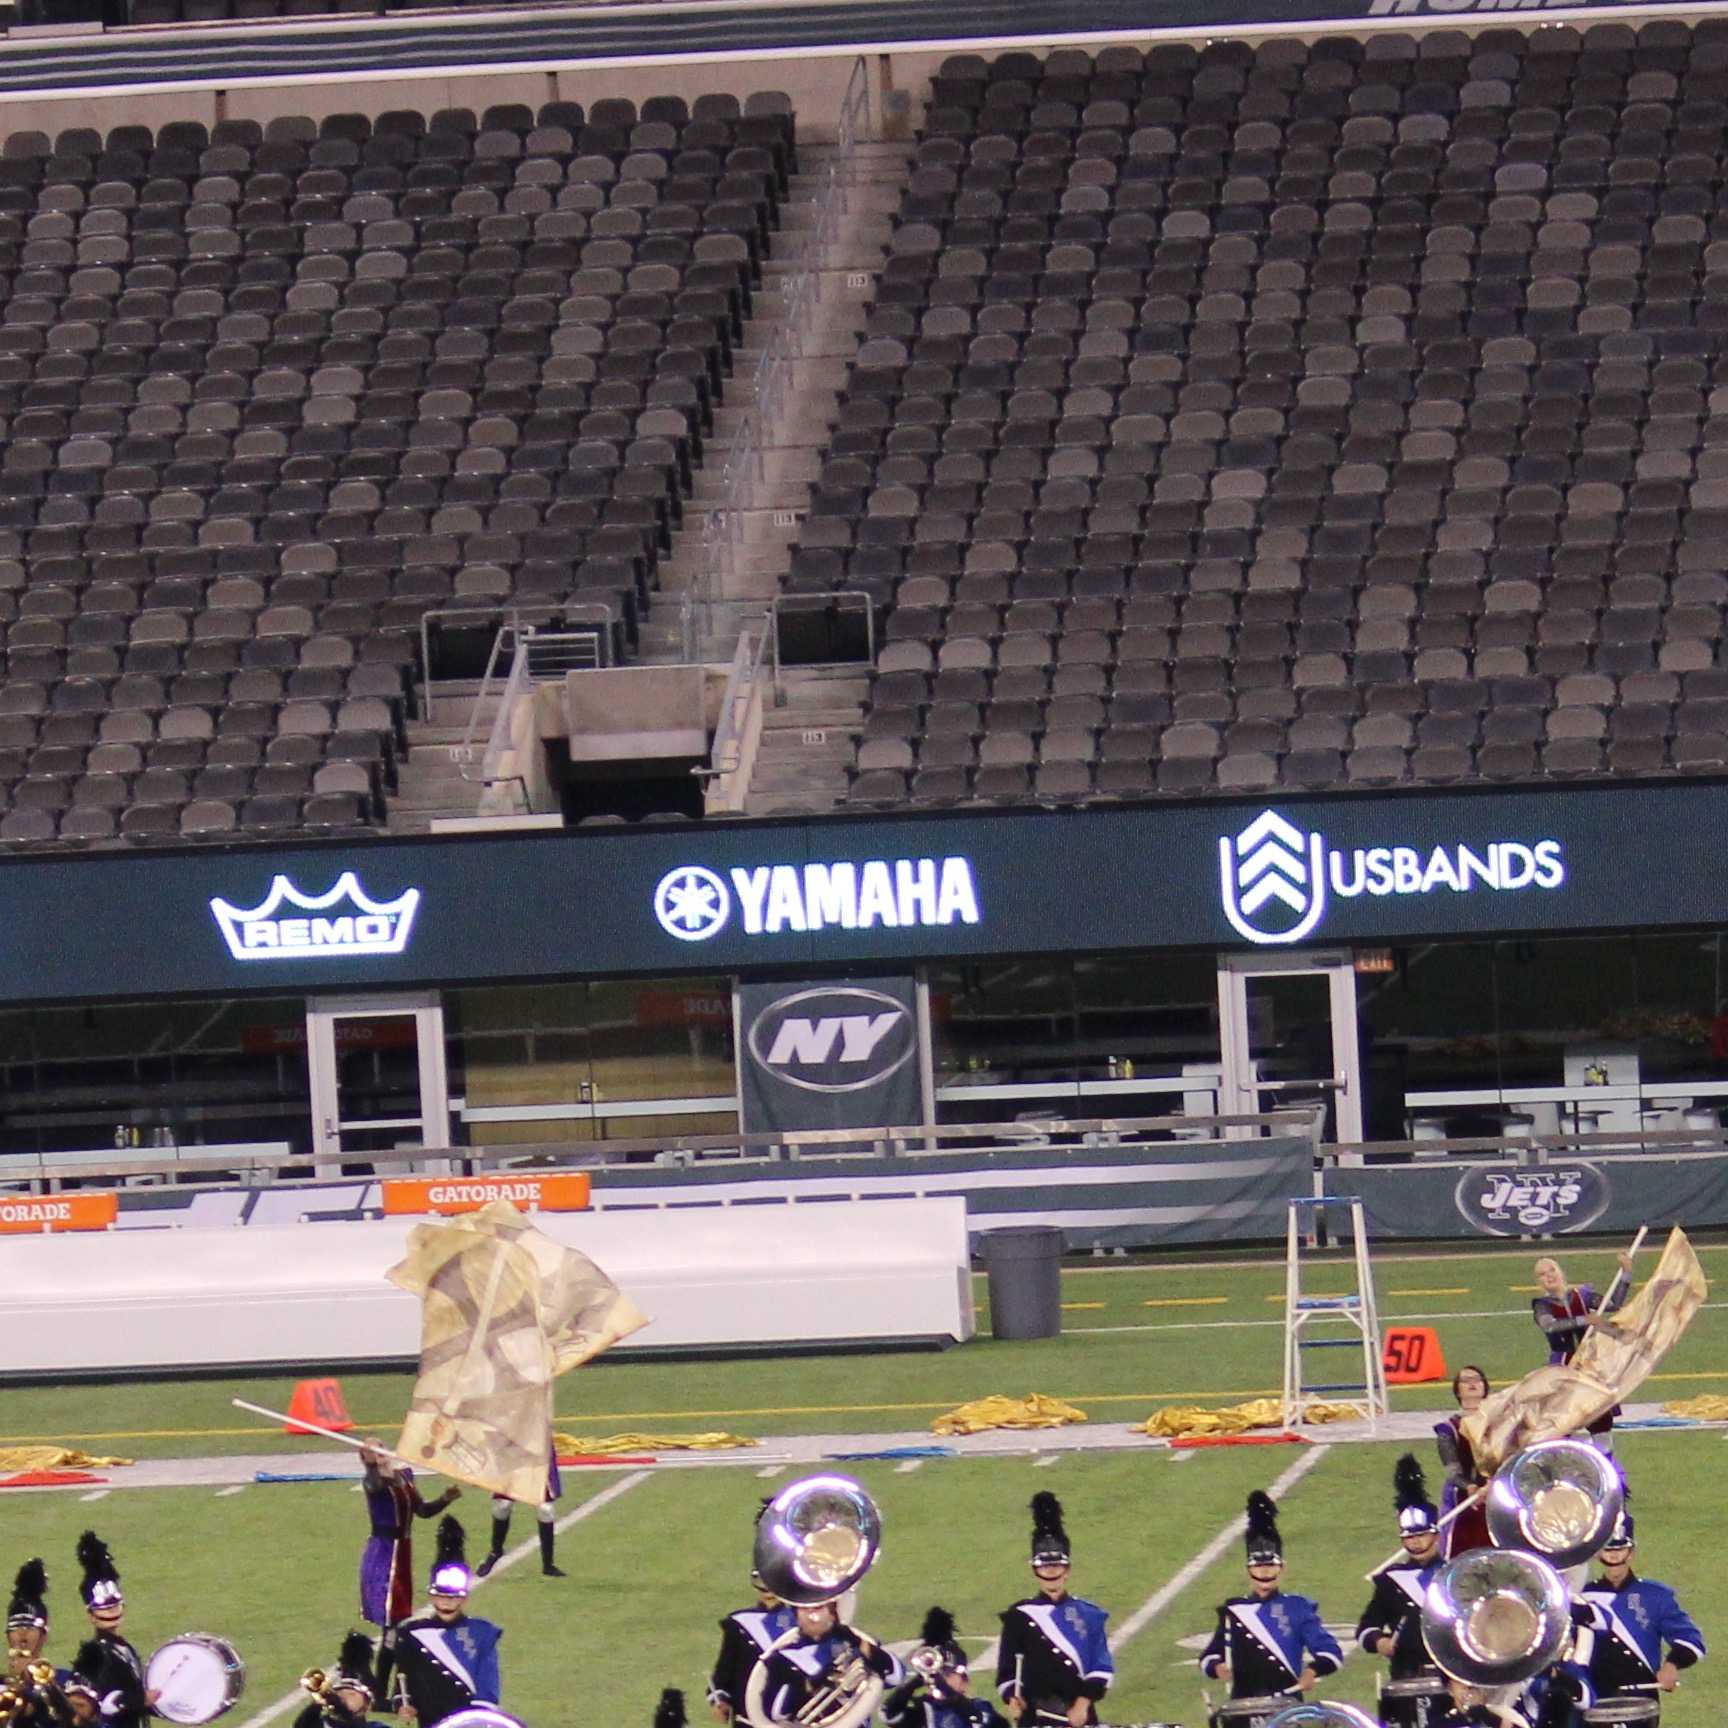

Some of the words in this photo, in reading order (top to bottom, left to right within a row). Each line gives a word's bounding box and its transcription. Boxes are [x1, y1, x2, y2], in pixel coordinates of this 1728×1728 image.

[1329, 840, 1565, 897] USBANDS
[730, 856, 979, 934] YAMAHA
[243, 916, 391, 947] REMO
[766, 1011, 903, 1064] NY
[428, 1183, 542, 1204] GATORADE
[1480, 1182, 1581, 1208] JETS
[1383, 1334, 1425, 1373] 50
